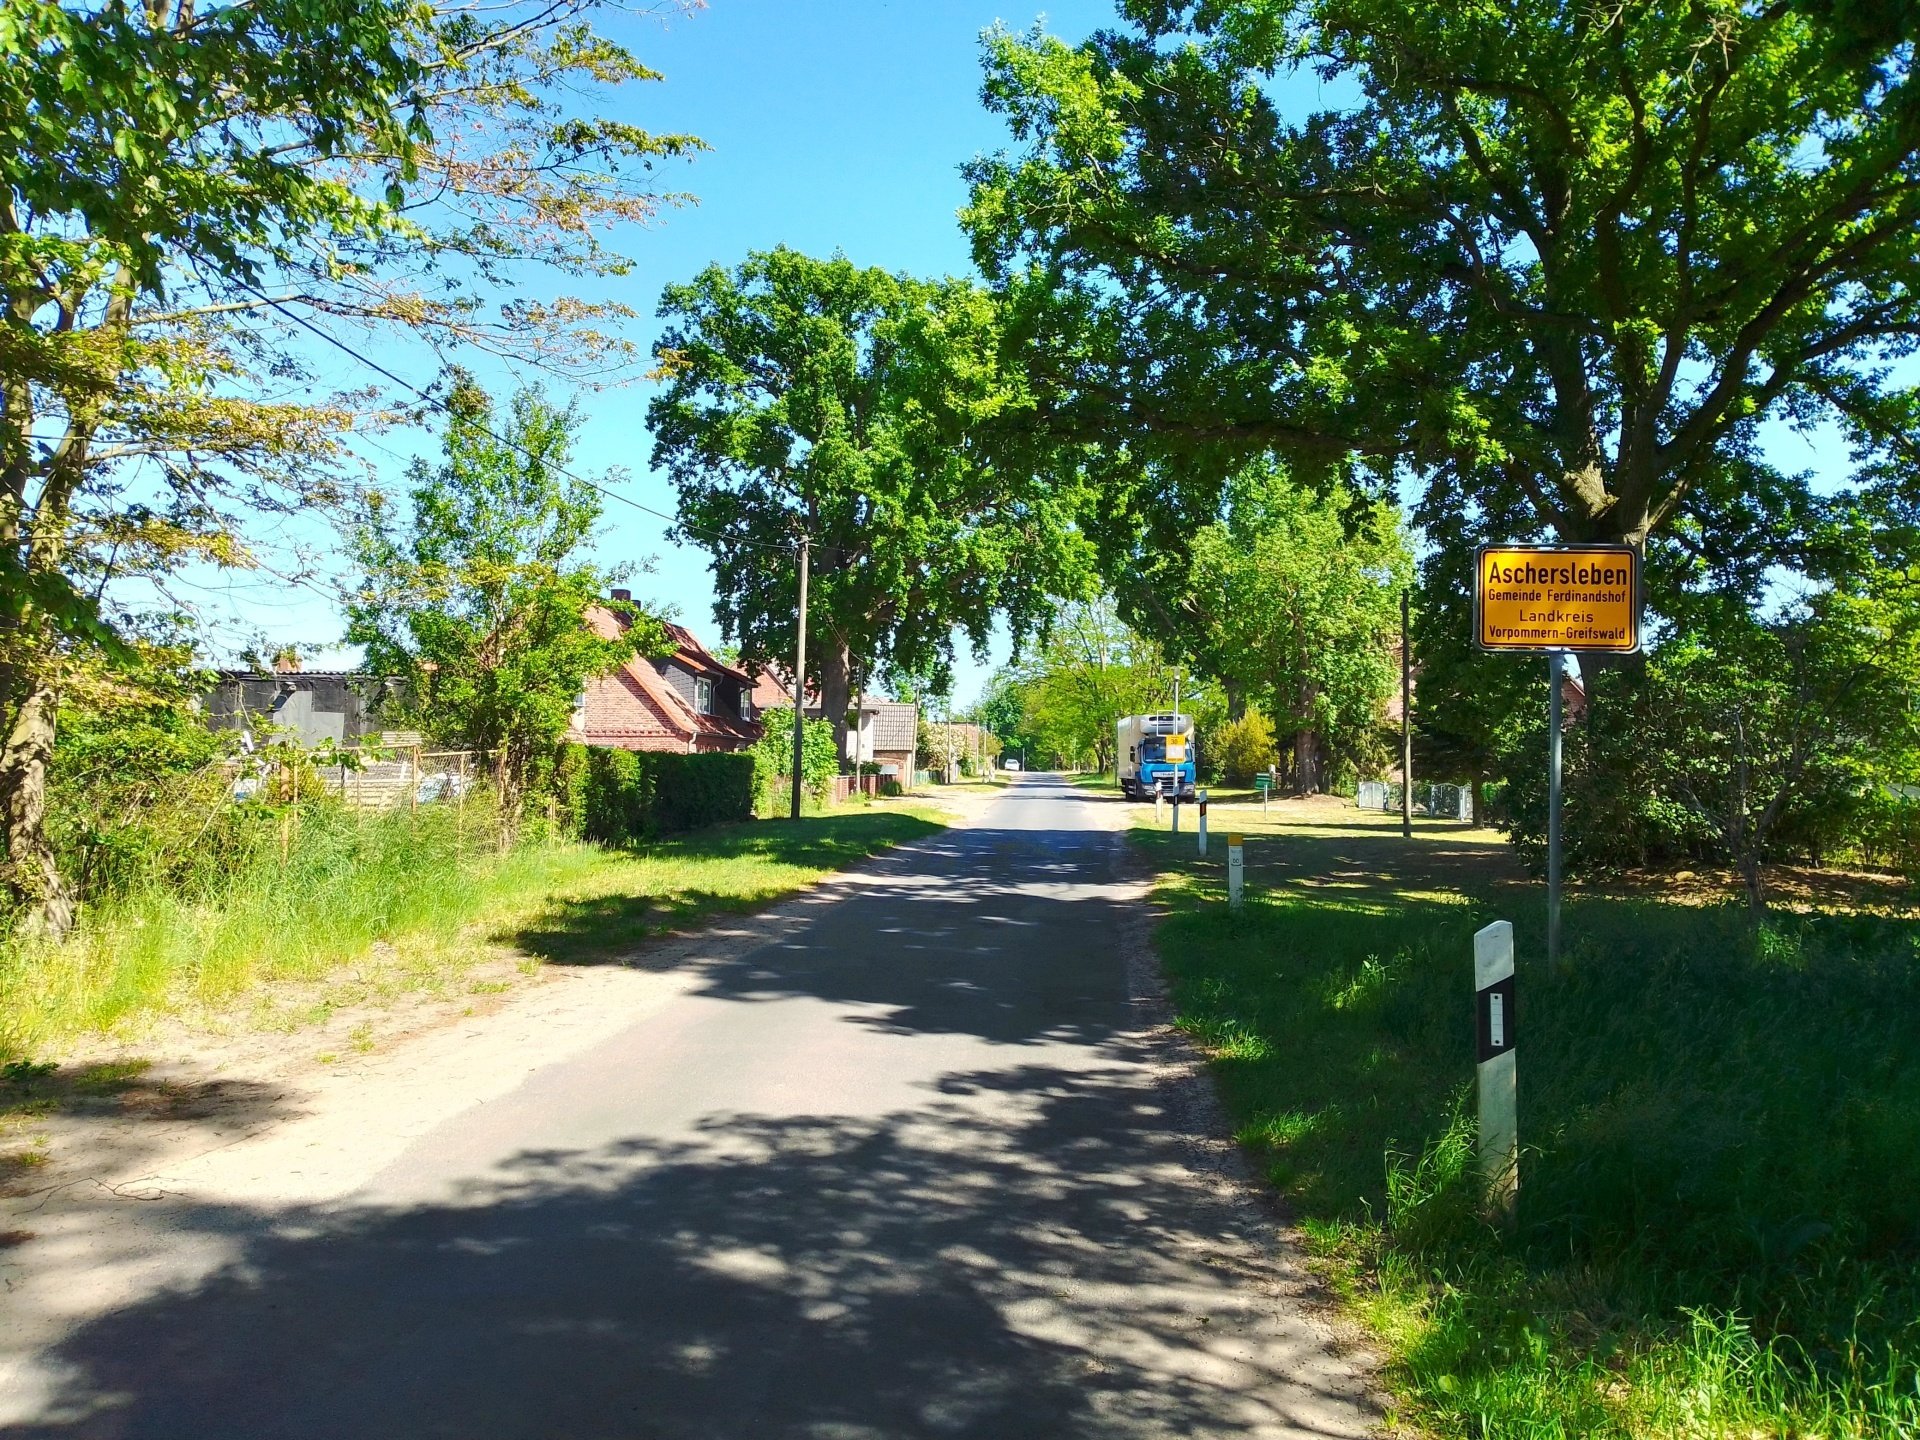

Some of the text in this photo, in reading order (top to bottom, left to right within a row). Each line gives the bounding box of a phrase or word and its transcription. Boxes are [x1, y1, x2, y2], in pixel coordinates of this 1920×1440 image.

[1489, 562, 1627, 585] Aschersleben
[1488, 588, 1626, 603] Gemeinde Ferdinandshof
[1519, 609, 1594, 623] Landkreis
[1489, 625, 1625, 640] Vorpommern-Greifswald
